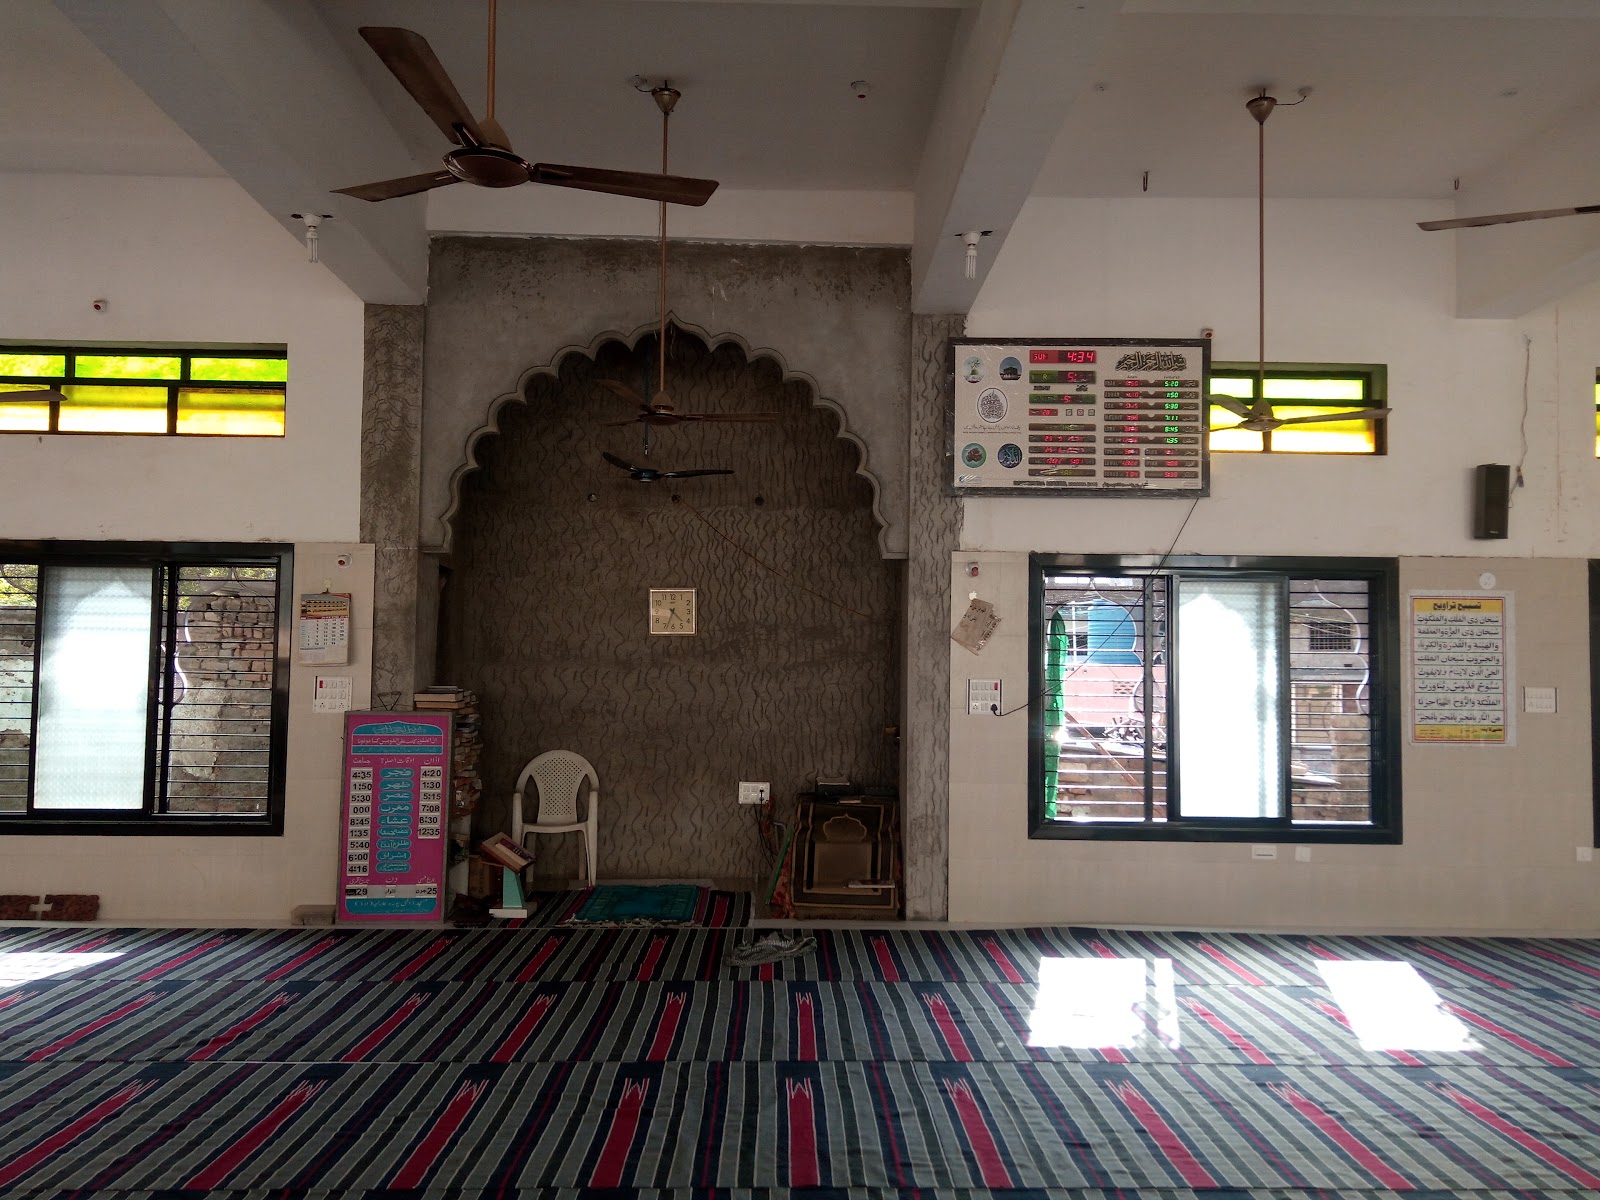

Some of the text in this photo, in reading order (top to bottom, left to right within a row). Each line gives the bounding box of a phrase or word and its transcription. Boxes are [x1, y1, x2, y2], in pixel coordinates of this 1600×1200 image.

[1067, 351, 1094, 362] 4:34
[1433, 601, 1456, 610] تراويح
[352, 771, 372, 779] 4:35
[384, 768, 412, 778] فجر
[380, 804, 410, 813] مغرب
[381, 816, 408, 825] عشاء
[348, 853, 368, 862] 6:00
